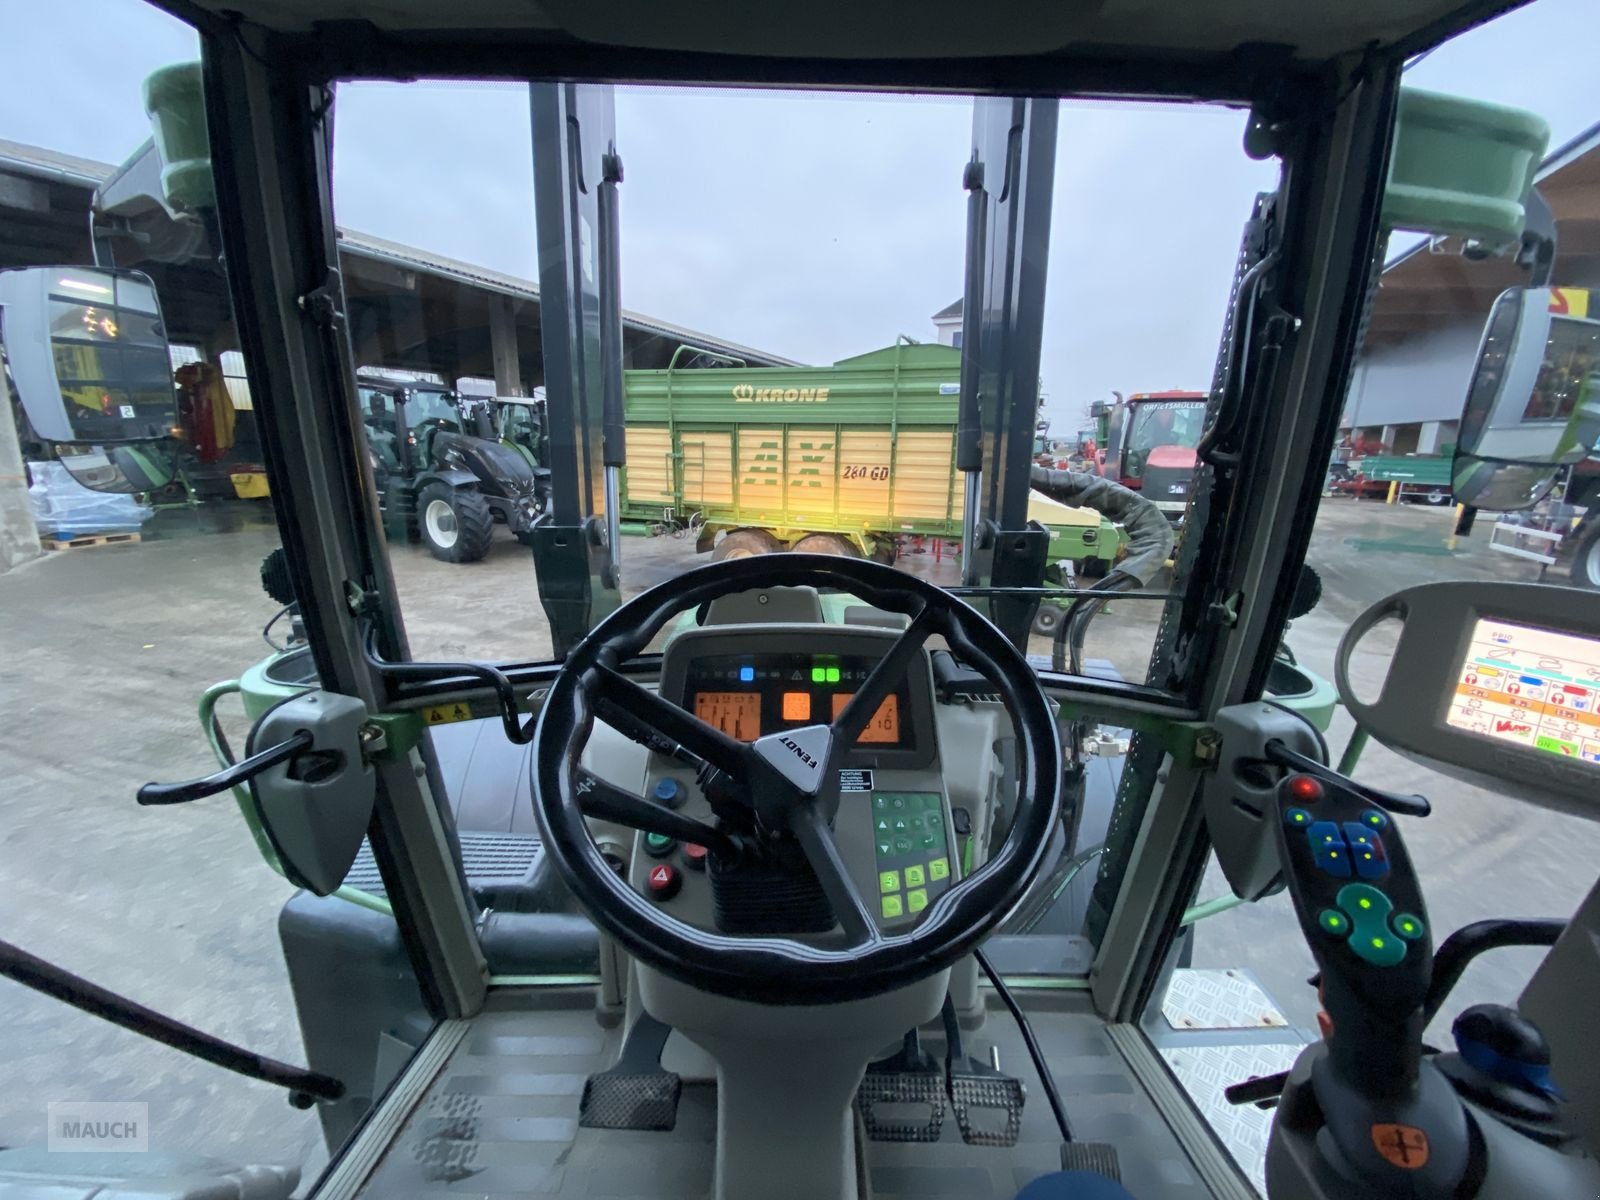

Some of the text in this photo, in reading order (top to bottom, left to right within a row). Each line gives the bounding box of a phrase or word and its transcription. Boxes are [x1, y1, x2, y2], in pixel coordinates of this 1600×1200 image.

[755, 387, 830, 402] KRONE
[870, 466, 889, 481] GD
[778, 737, 817, 768] FENDT
